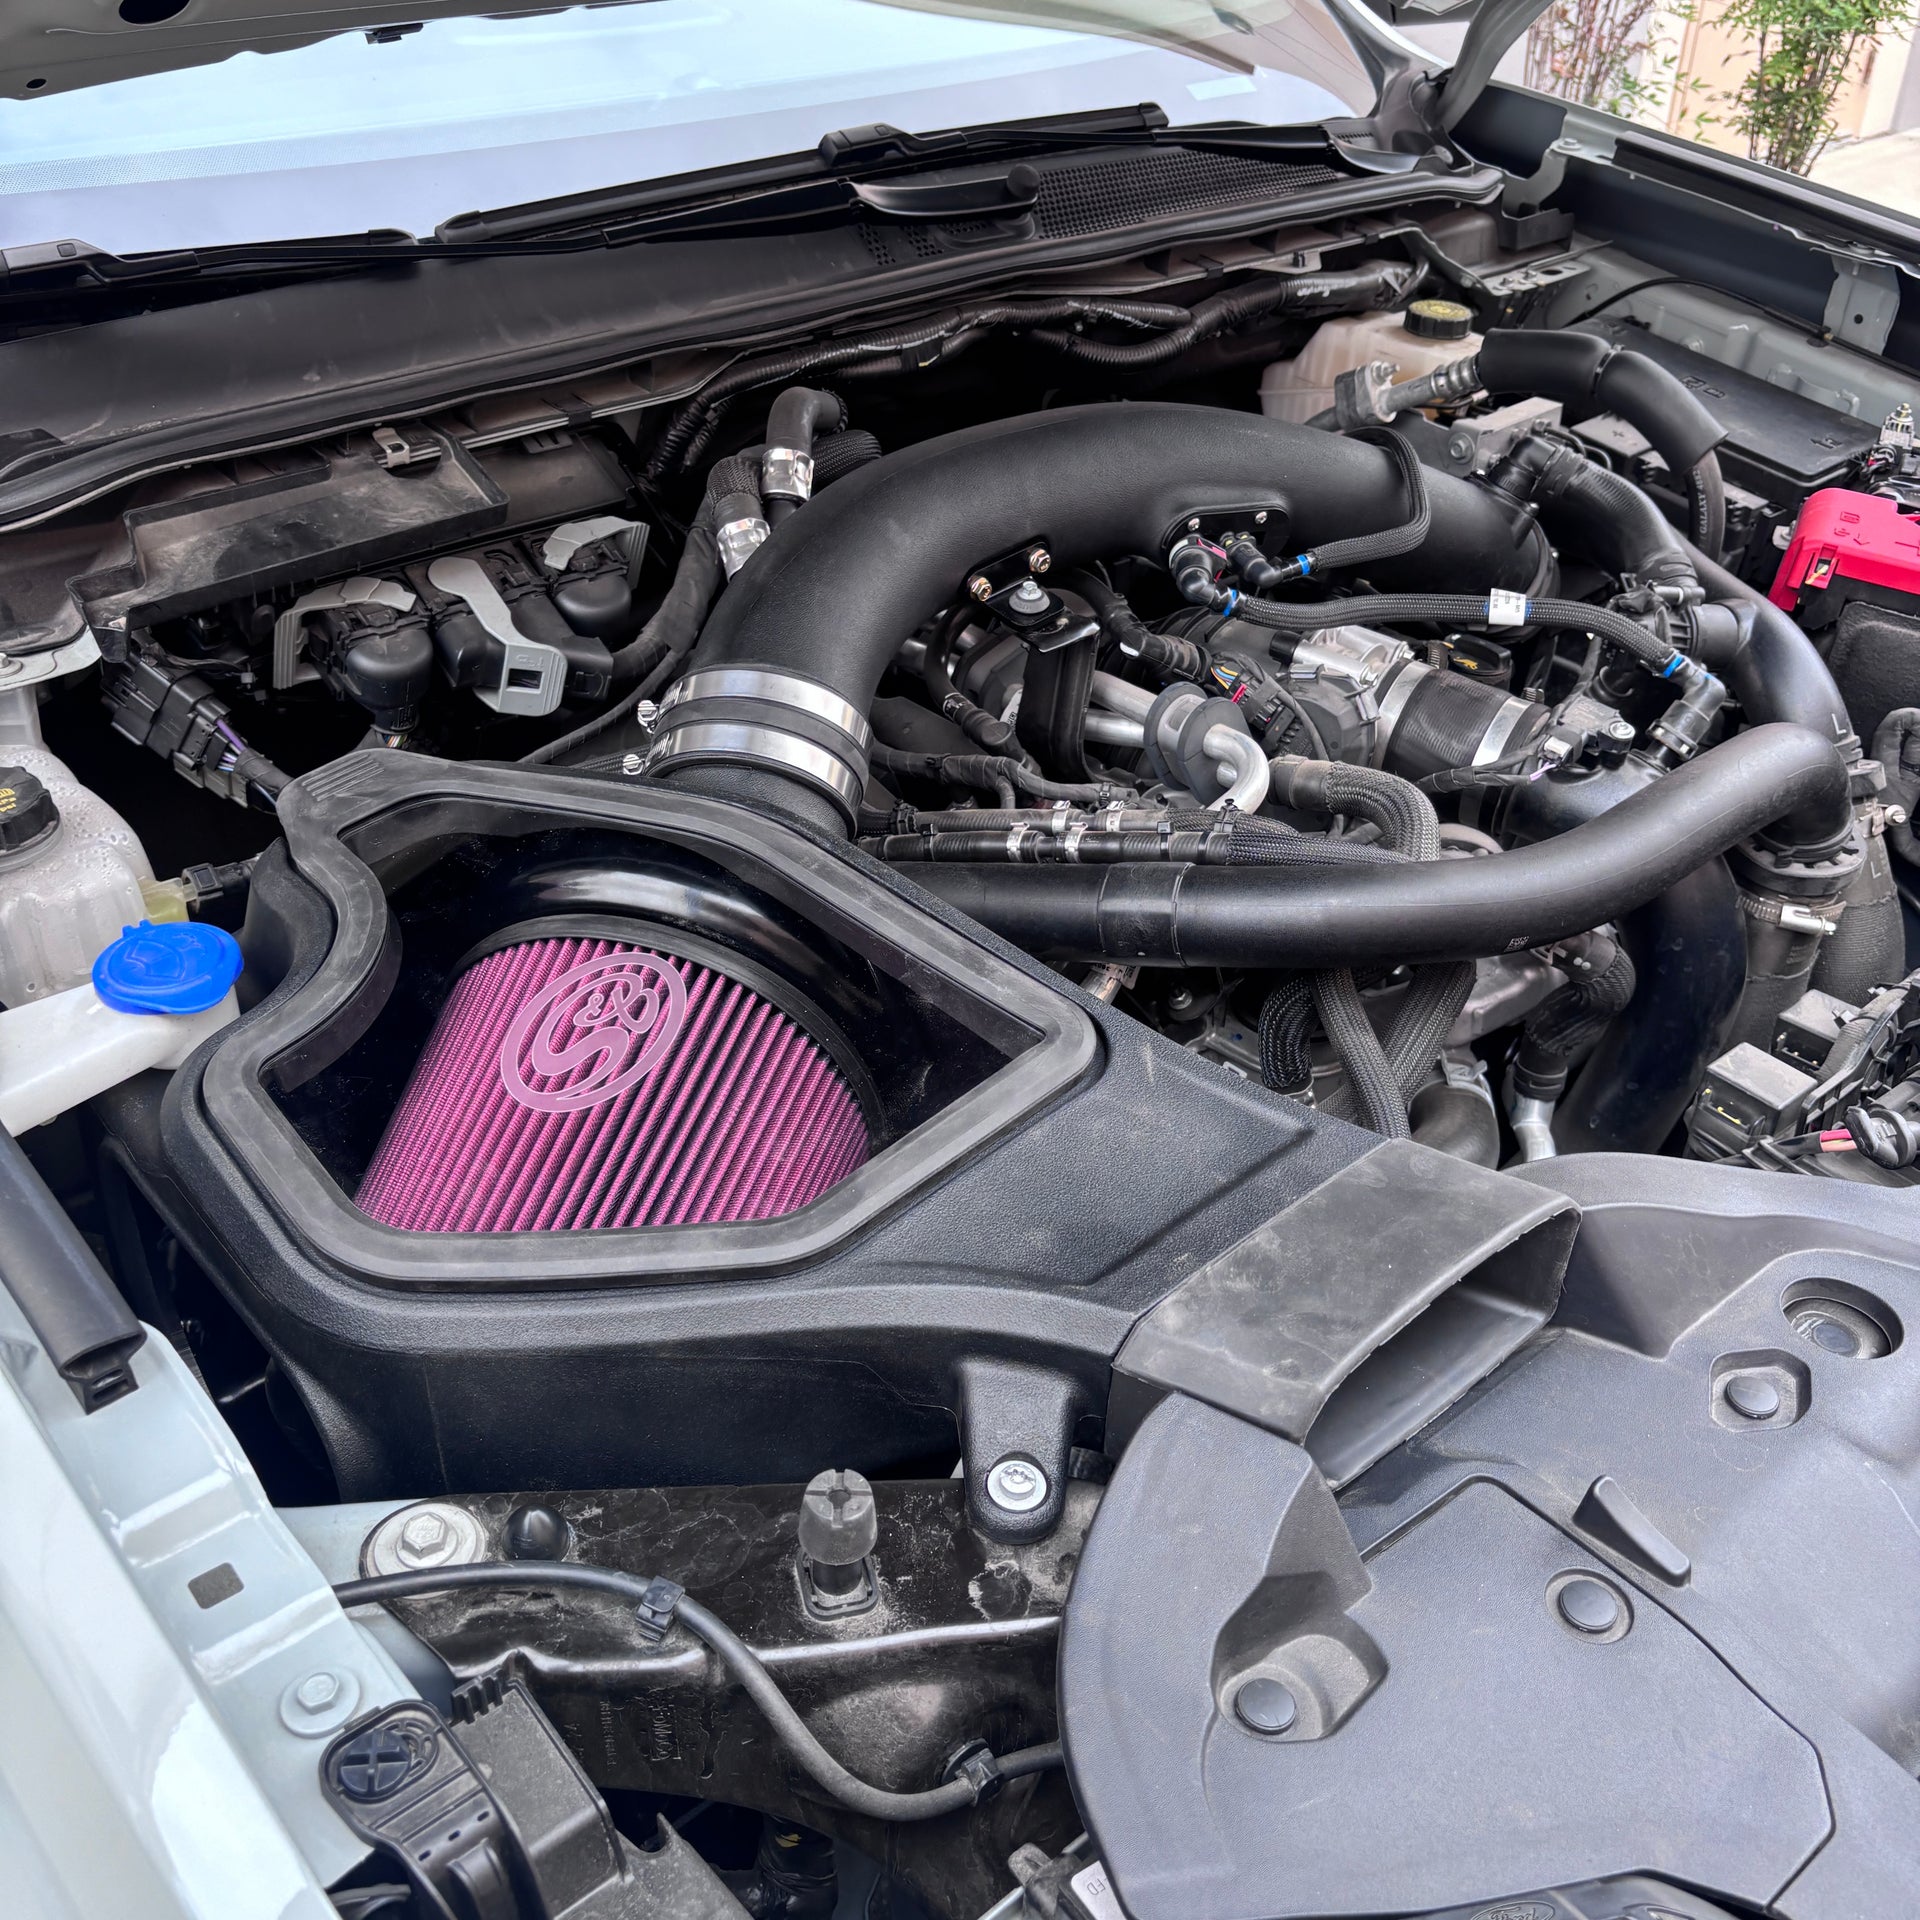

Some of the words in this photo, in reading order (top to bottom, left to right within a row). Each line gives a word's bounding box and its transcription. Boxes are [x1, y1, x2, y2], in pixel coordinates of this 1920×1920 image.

[1698, 493, 1707, 533] GALAXY
[1832, 713, 1846, 735] L
[1870, 861, 1882, 879] L
